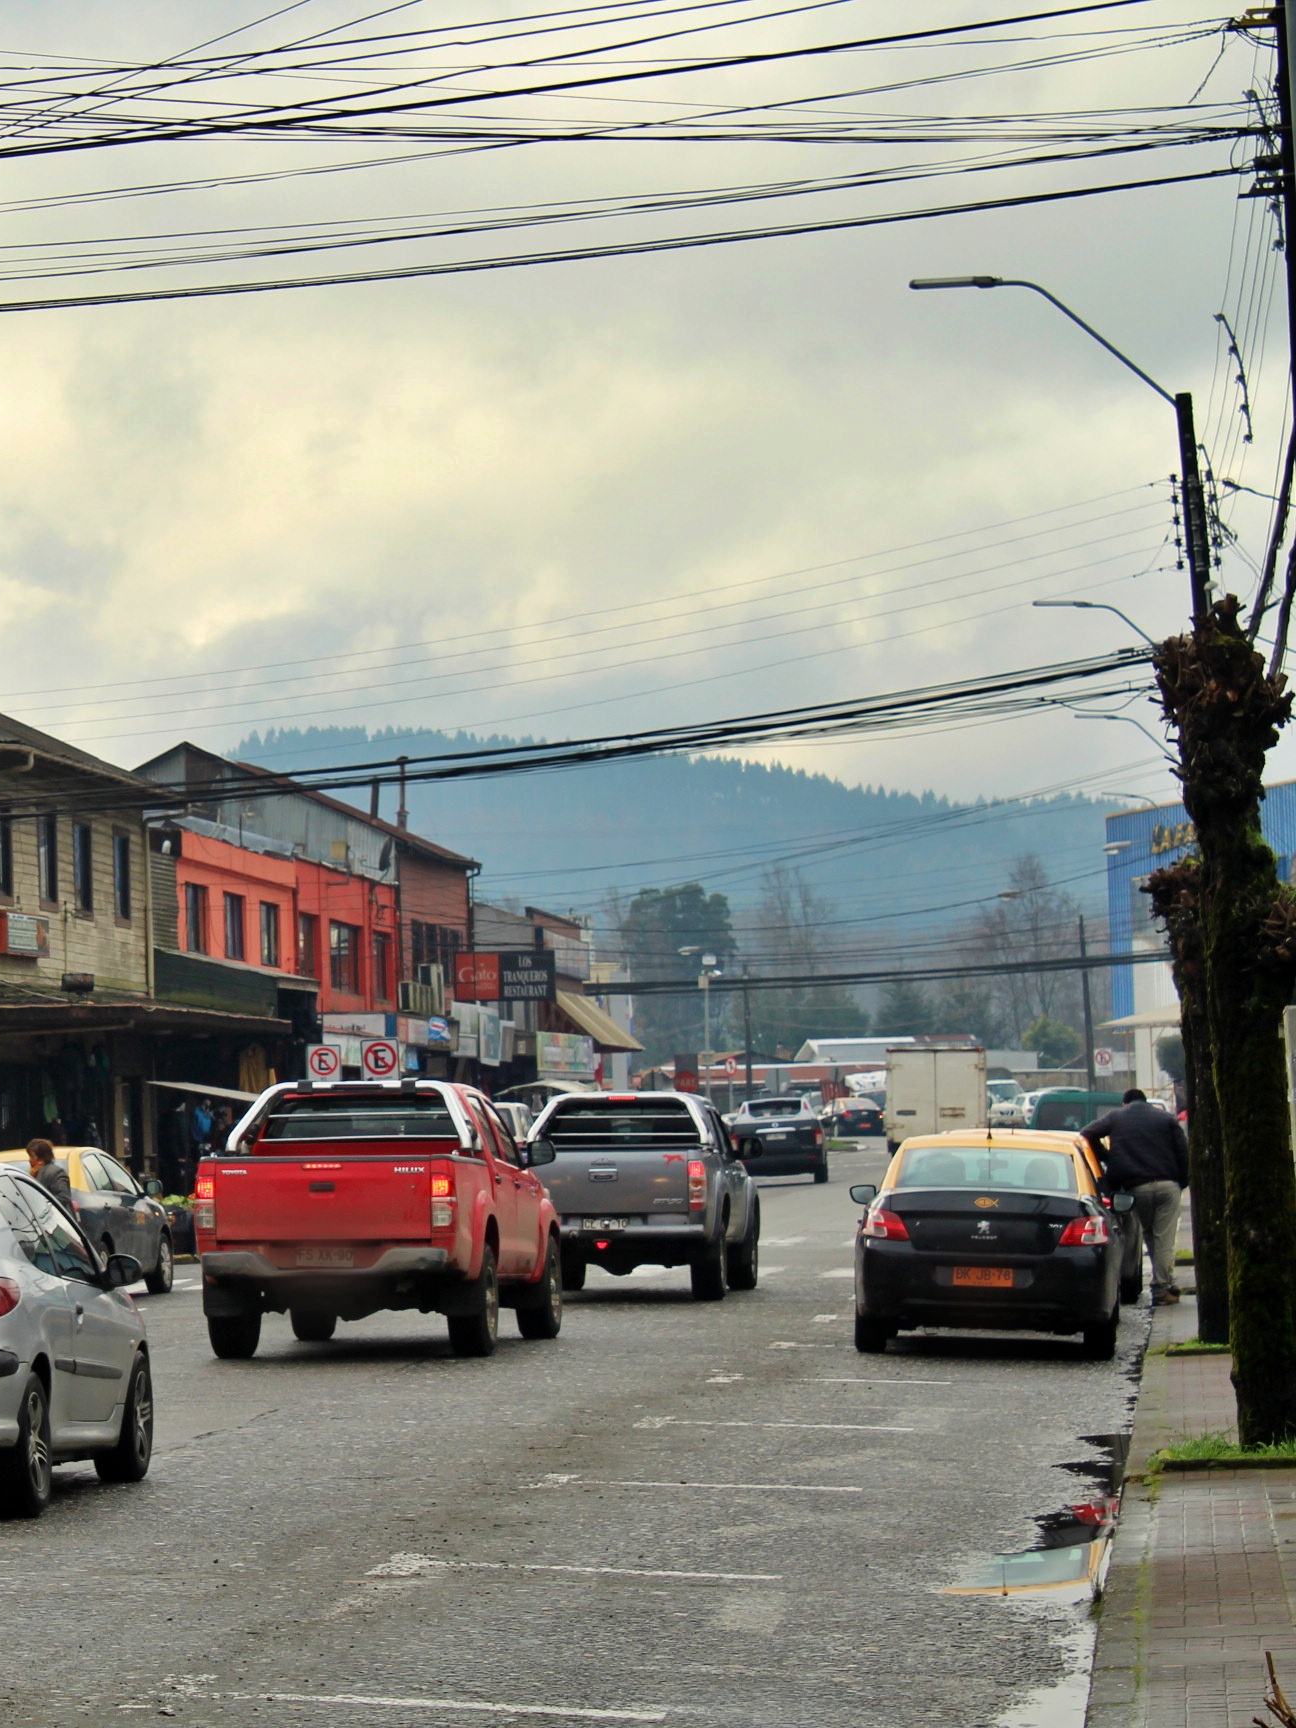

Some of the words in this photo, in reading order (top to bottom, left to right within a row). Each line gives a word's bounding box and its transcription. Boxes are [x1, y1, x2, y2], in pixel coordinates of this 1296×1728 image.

[518, 955, 532, 968] LOS
[458, 966, 497, 984] Gato
[504, 970, 548, 985] TRANQUEROS
[504, 985, 548, 997] RESTAURANT
